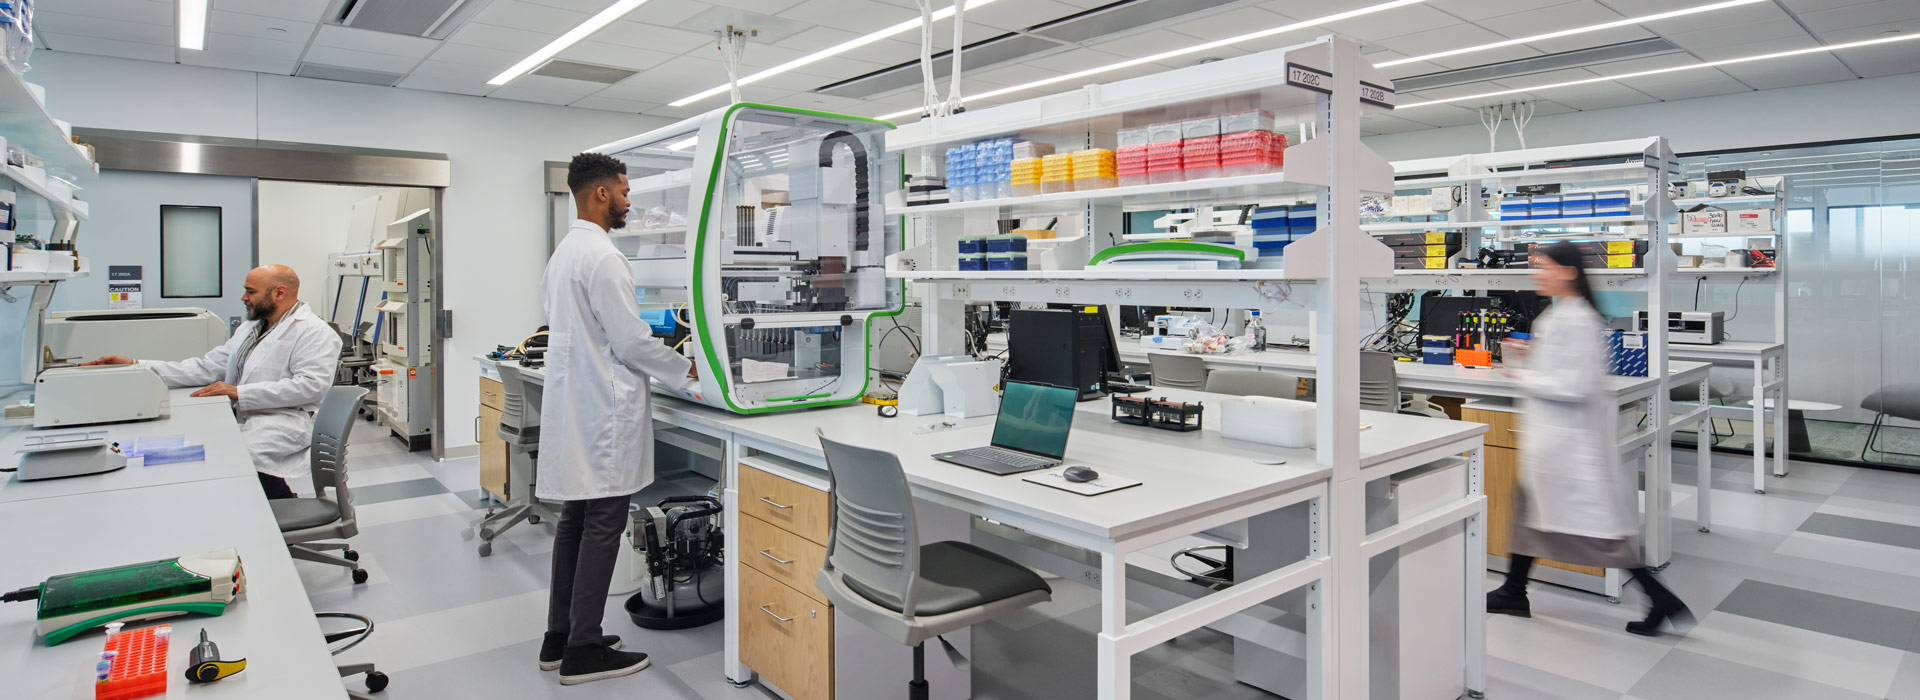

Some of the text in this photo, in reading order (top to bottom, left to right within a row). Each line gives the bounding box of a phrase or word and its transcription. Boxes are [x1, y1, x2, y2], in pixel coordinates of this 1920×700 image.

[1293, 70, 1320, 86] 17 202C
[1362, 87, 1384, 101] 17 202B
